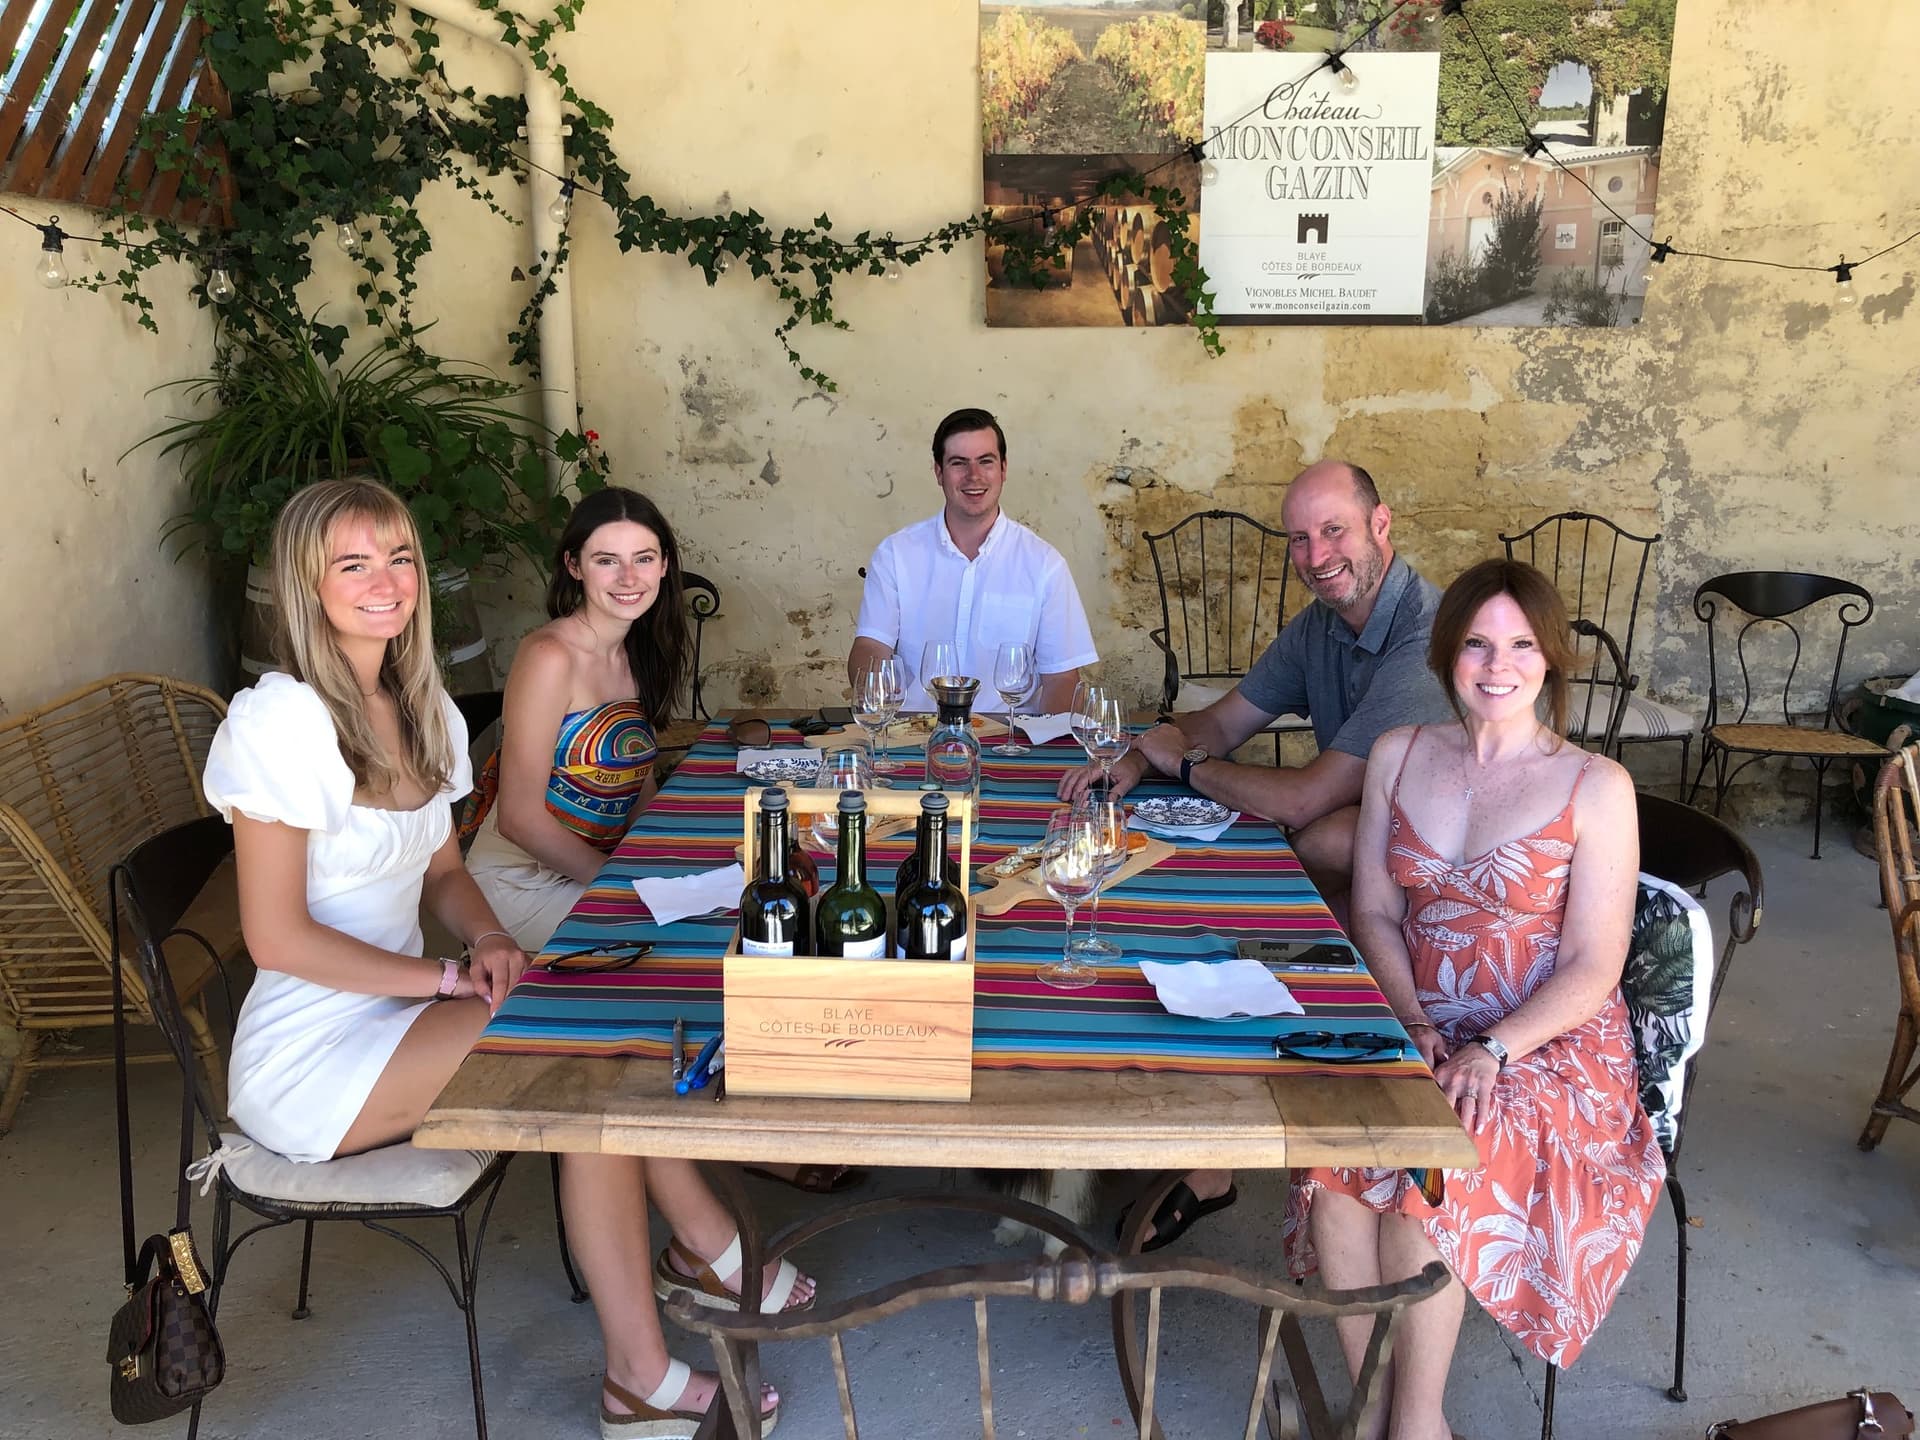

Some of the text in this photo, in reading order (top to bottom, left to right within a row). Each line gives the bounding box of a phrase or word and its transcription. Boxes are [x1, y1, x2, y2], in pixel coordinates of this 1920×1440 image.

[1263, 74, 1383, 120] Château
[1209, 125, 1428, 161] MONCONSEIL
[1265, 165, 1373, 200] GAZIN
[1297, 252, 1327, 261] BLAYE
[1261, 261, 1362, 271] CÔTES DE BORDEAUX
[1245, 287, 1378, 298] VIGNOBLES MICHEL BAUDET
[1249, 301, 1371, 311] www.monconseilgazin.com
[823, 1007, 873, 1020] BLAYE
[759, 1019, 938, 1037] CÔTES DE BORDEAUX
